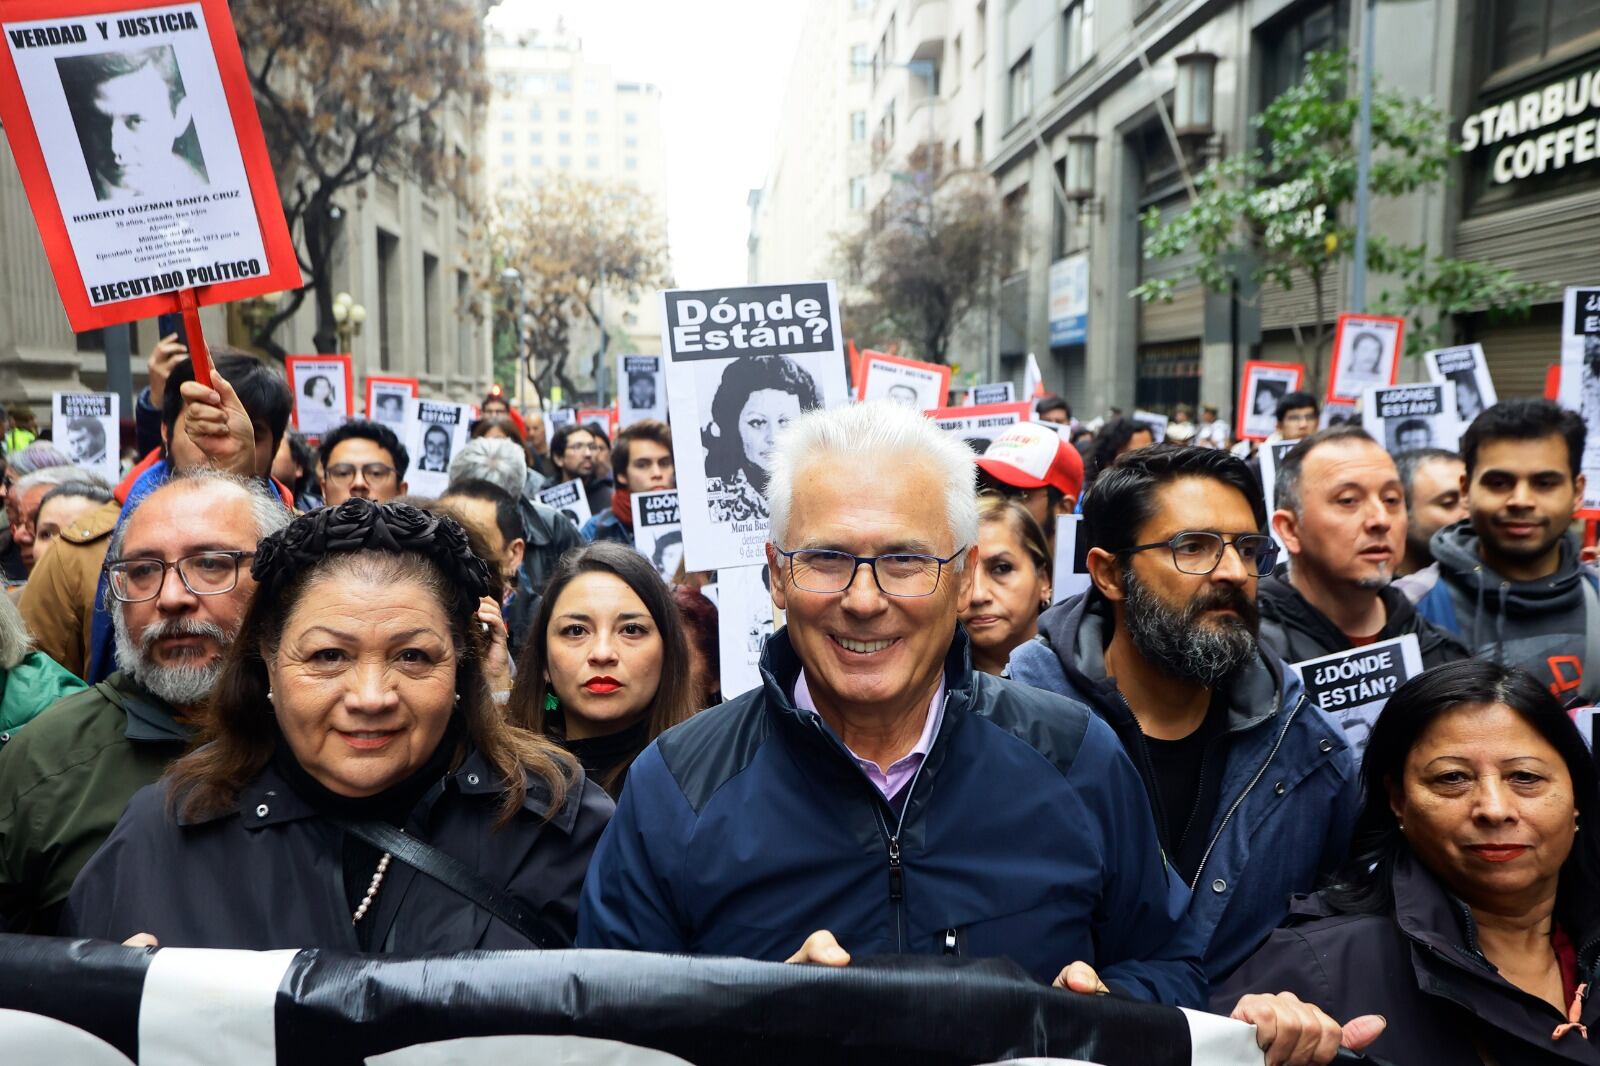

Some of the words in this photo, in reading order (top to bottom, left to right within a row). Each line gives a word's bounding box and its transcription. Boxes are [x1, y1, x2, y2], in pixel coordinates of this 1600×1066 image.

[8, 24, 88, 49] VERDAD
[95, 21, 108, 40] Y
[117, 11, 198, 39] JUSTICIA
[1494, 118, 1600, 183] COFFE
[72, 208, 125, 223] ROBERTO
[127, 200, 173, 214] GUZMAN
[175, 194, 210, 207] SANTA
[212, 189, 240, 201] CRUZ
[90, 270, 184, 304] EJECUTADO
[185, 258, 261, 285] POLÍTICO
[676, 293, 822, 326] Dónde
[673, 317, 829, 353] Están?
[1314, 651, 1393, 686] ¿DÓNDE
[1318, 676, 1397, 709] ESTÁN?
